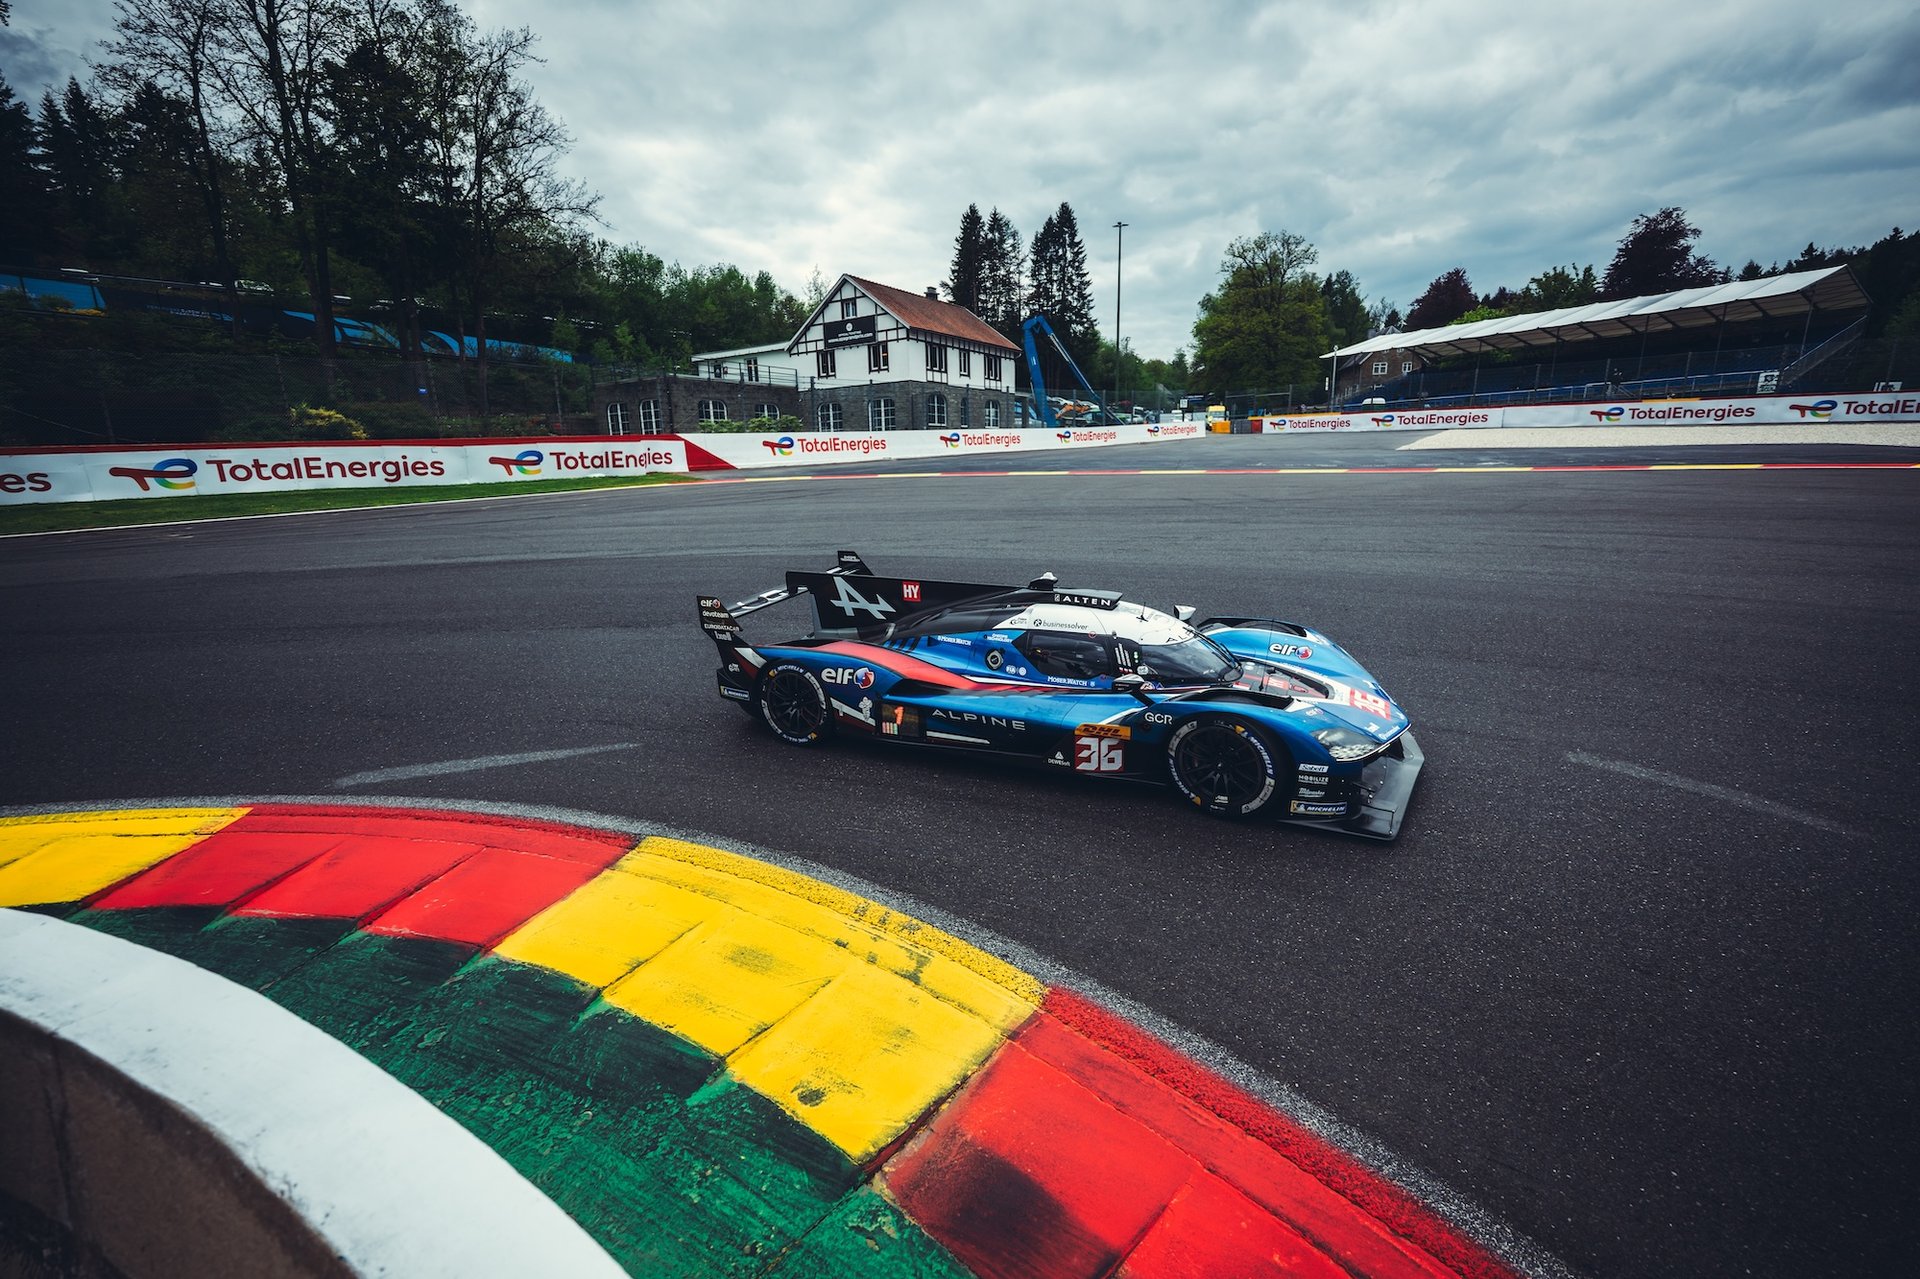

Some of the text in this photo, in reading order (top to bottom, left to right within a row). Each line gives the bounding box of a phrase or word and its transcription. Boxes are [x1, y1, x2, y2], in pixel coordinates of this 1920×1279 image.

[1397, 412, 1488, 426] TotalEnergies
[1629, 406, 1755, 421] TotalEnergies
[1288, 416, 1351, 430] TotalEnergies
[1072, 430, 1117, 442] TotalEnergies
[1161, 425, 1197, 436] TotalEnergies
[797, 436, 887, 454] TotalEnergies
[962, 432, 1021, 447] TotalEnergies
[206, 455, 445, 483] TotalEnergies
[903, 584, 920, 599] HY
[700, 599, 713, 608] elf
[1062, 595, 1111, 606] ALTEN
[1042, 620, 1088, 631] businessolver
[1269, 643, 1297, 656] elf
[820, 667, 854, 685] elf
[932, 708, 1026, 731] ALPINE
[1144, 711, 1173, 725] GCR
[1082, 725, 1123, 736] DHL
[1076, 737, 1123, 771] 36
[1298, 774, 1329, 783] MOBILIZE
